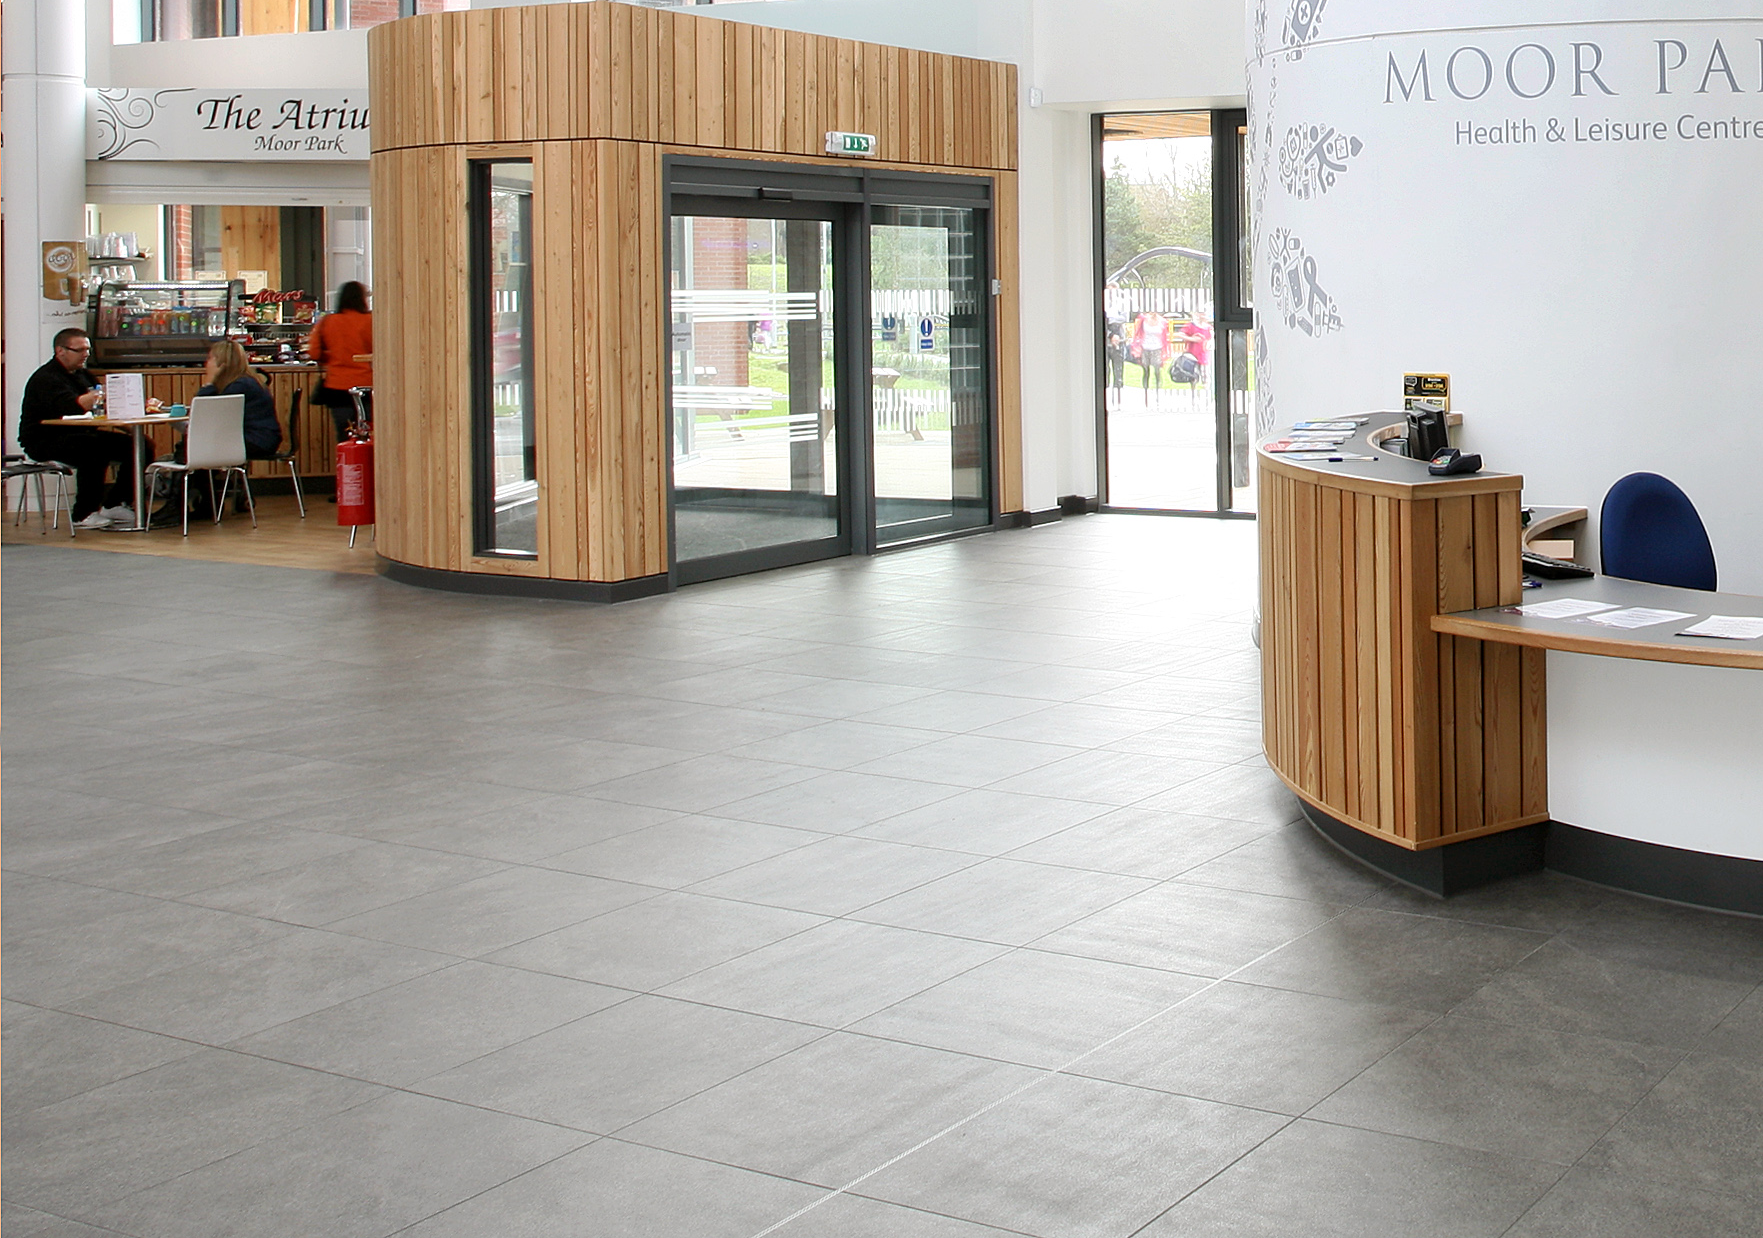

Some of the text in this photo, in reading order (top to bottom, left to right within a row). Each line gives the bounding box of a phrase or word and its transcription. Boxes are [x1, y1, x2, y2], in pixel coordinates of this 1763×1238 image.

[1382, 41, 1620, 105] MOOR
[197, 94, 262, 130] The
[254, 133, 348, 155] Moor Park
[1454, 117, 1538, 146] Health
[1545, 118, 1566, 143] &
[1574, 115, 1668, 142] Leisure
[253, 288, 305, 303] Mars
